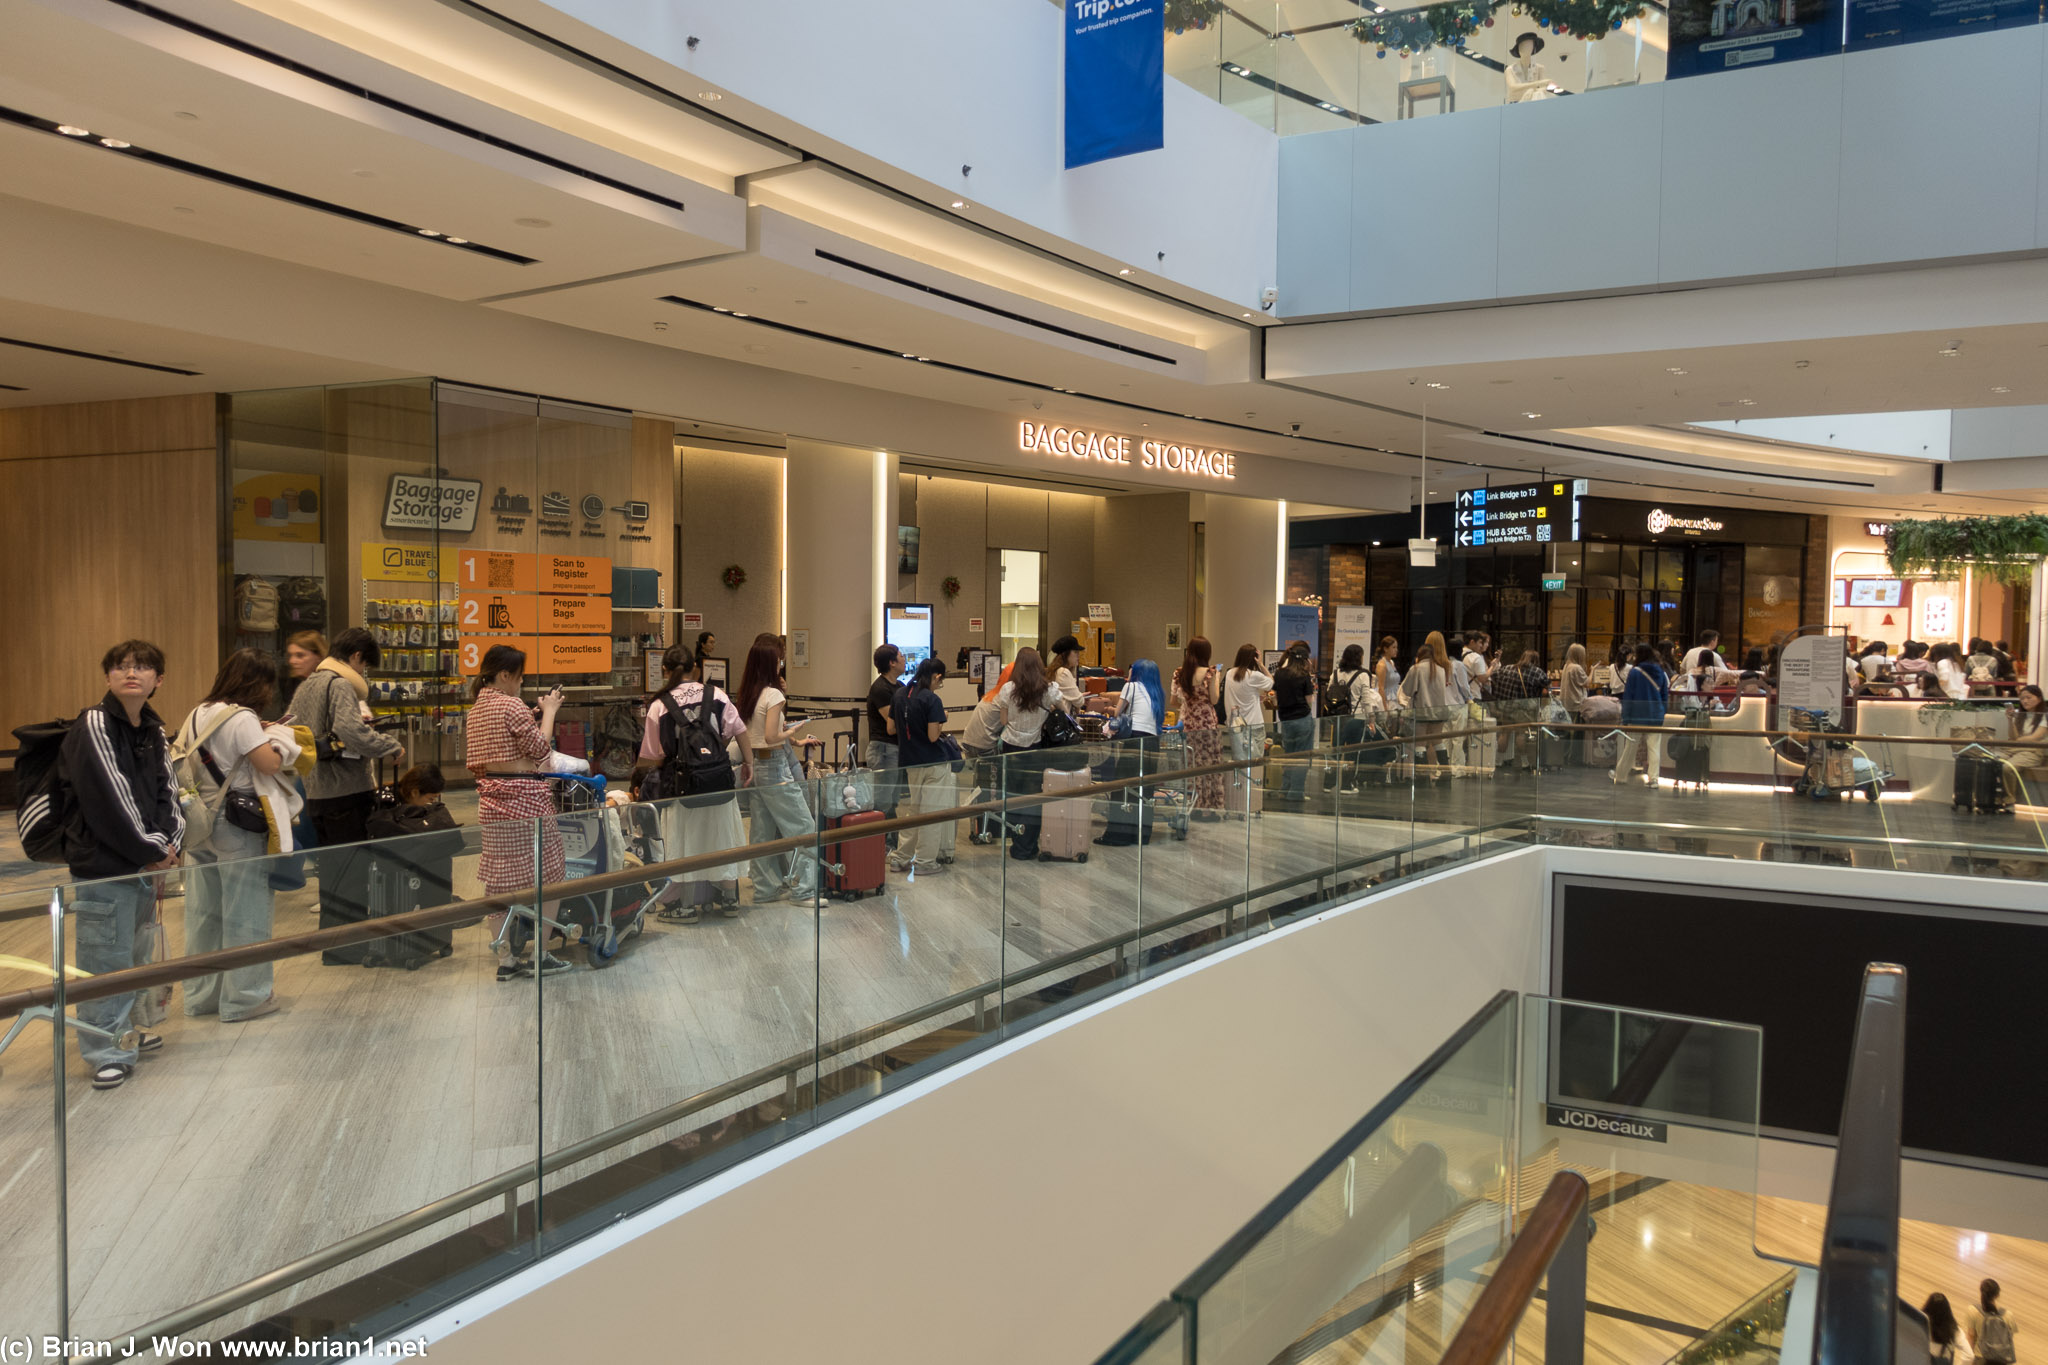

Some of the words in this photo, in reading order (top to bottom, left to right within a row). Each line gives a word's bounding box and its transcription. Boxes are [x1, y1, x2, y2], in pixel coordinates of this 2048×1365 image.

[1075, 26, 1087, 35] Your
[1088, 20, 1108, 31] trusted
[1020, 422, 1132, 462] BAGGAGE
[1142, 441, 1237, 478] STORAGE
[396, 480, 475, 505] Baggage
[1487, 492, 1499, 500] Link
[1500, 490, 1519, 500] Bridge
[1528, 488, 1536, 496] T3
[392, 498, 462, 522] Storage
[1500, 511, 1518, 520] Bridge
[1507, 527, 1527, 535] SPOKE
[553, 558, 574, 567] Scan
[576, 560, 584, 568] to
[464, 557, 475, 582] 1
[553, 569, 588, 579] Register
[1549, 581, 1562, 589] EXIT
[553, 599, 586, 609] Prepare
[464, 600, 479, 624] 2
[553, 609, 575, 619] Bags
[553, 645, 602, 653] Contactless
[464, 643, 479, 668] 3
[1558, 1111, 1654, 1138] JCDecaux
